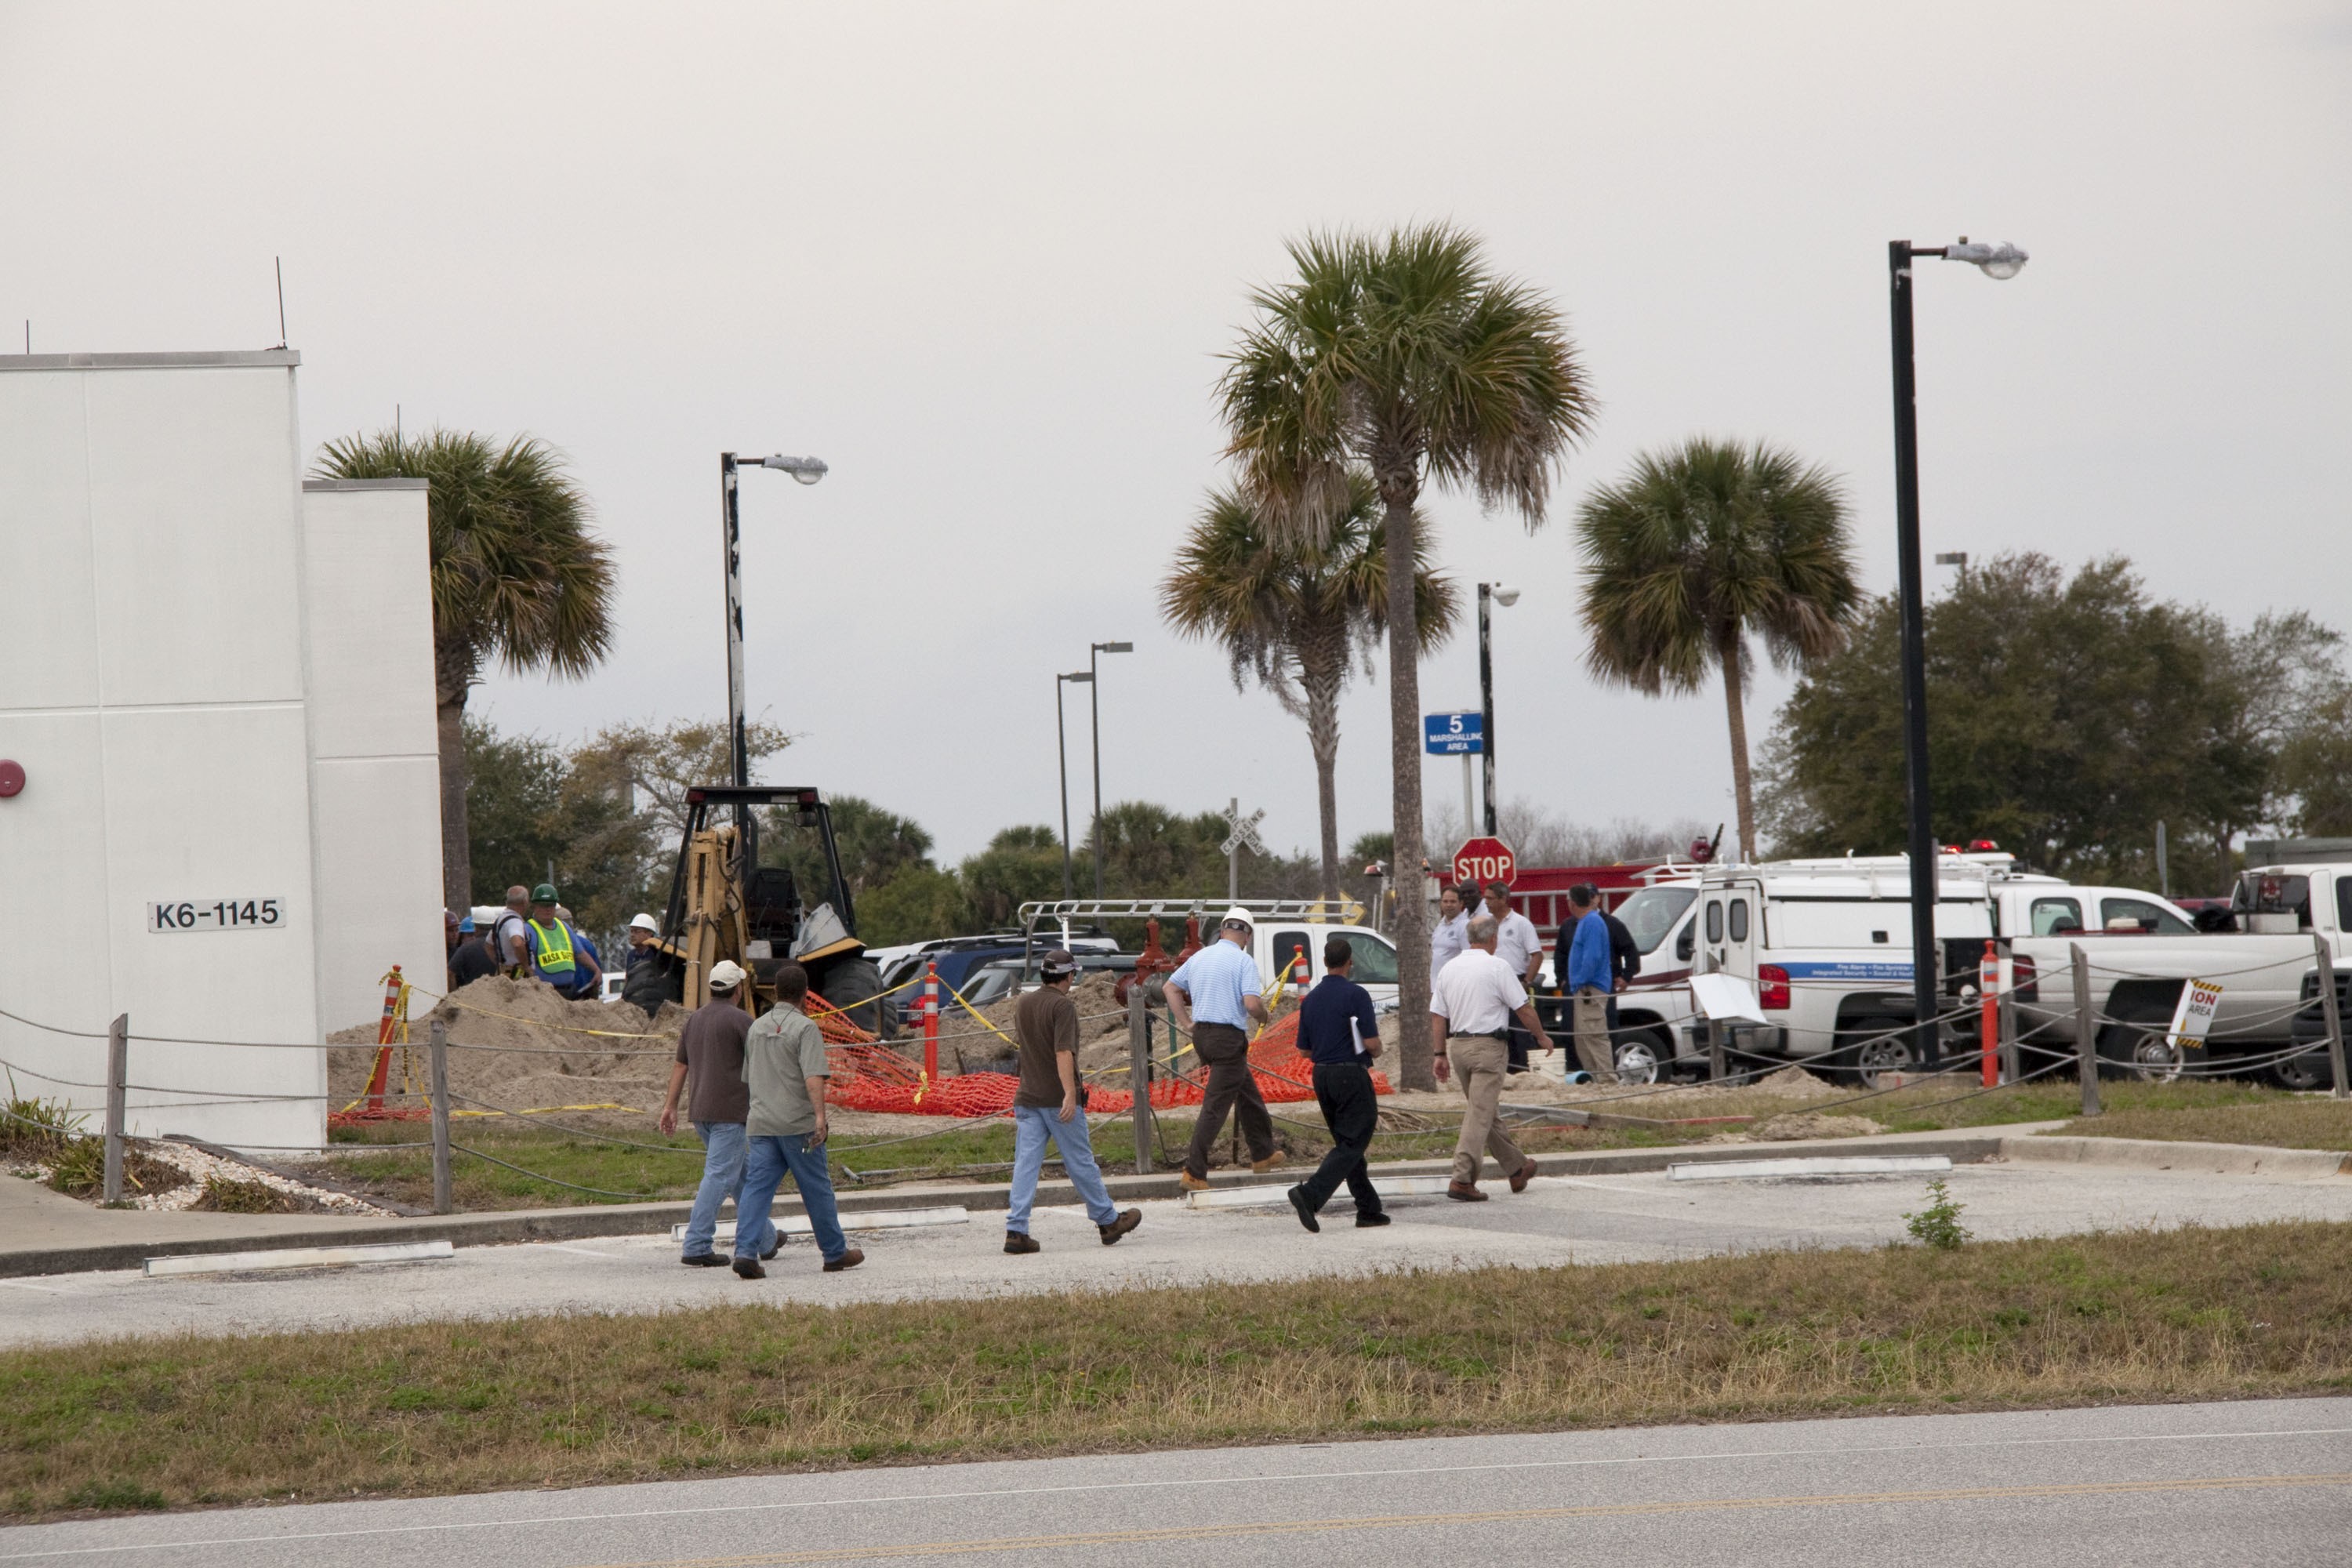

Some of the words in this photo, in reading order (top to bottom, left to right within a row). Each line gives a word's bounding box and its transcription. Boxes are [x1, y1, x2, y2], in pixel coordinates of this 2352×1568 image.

[1449, 714, 1463, 733] 5
[1446, 742, 1469, 751] AREA
[1222, 809, 1265, 853] CROSSING
[1458, 855, 1512, 880] STOP
[156, 900, 278, 929] K6-1145
[542, 953, 561, 965] NASA
[2187, 1004, 2211, 1017] AREA
